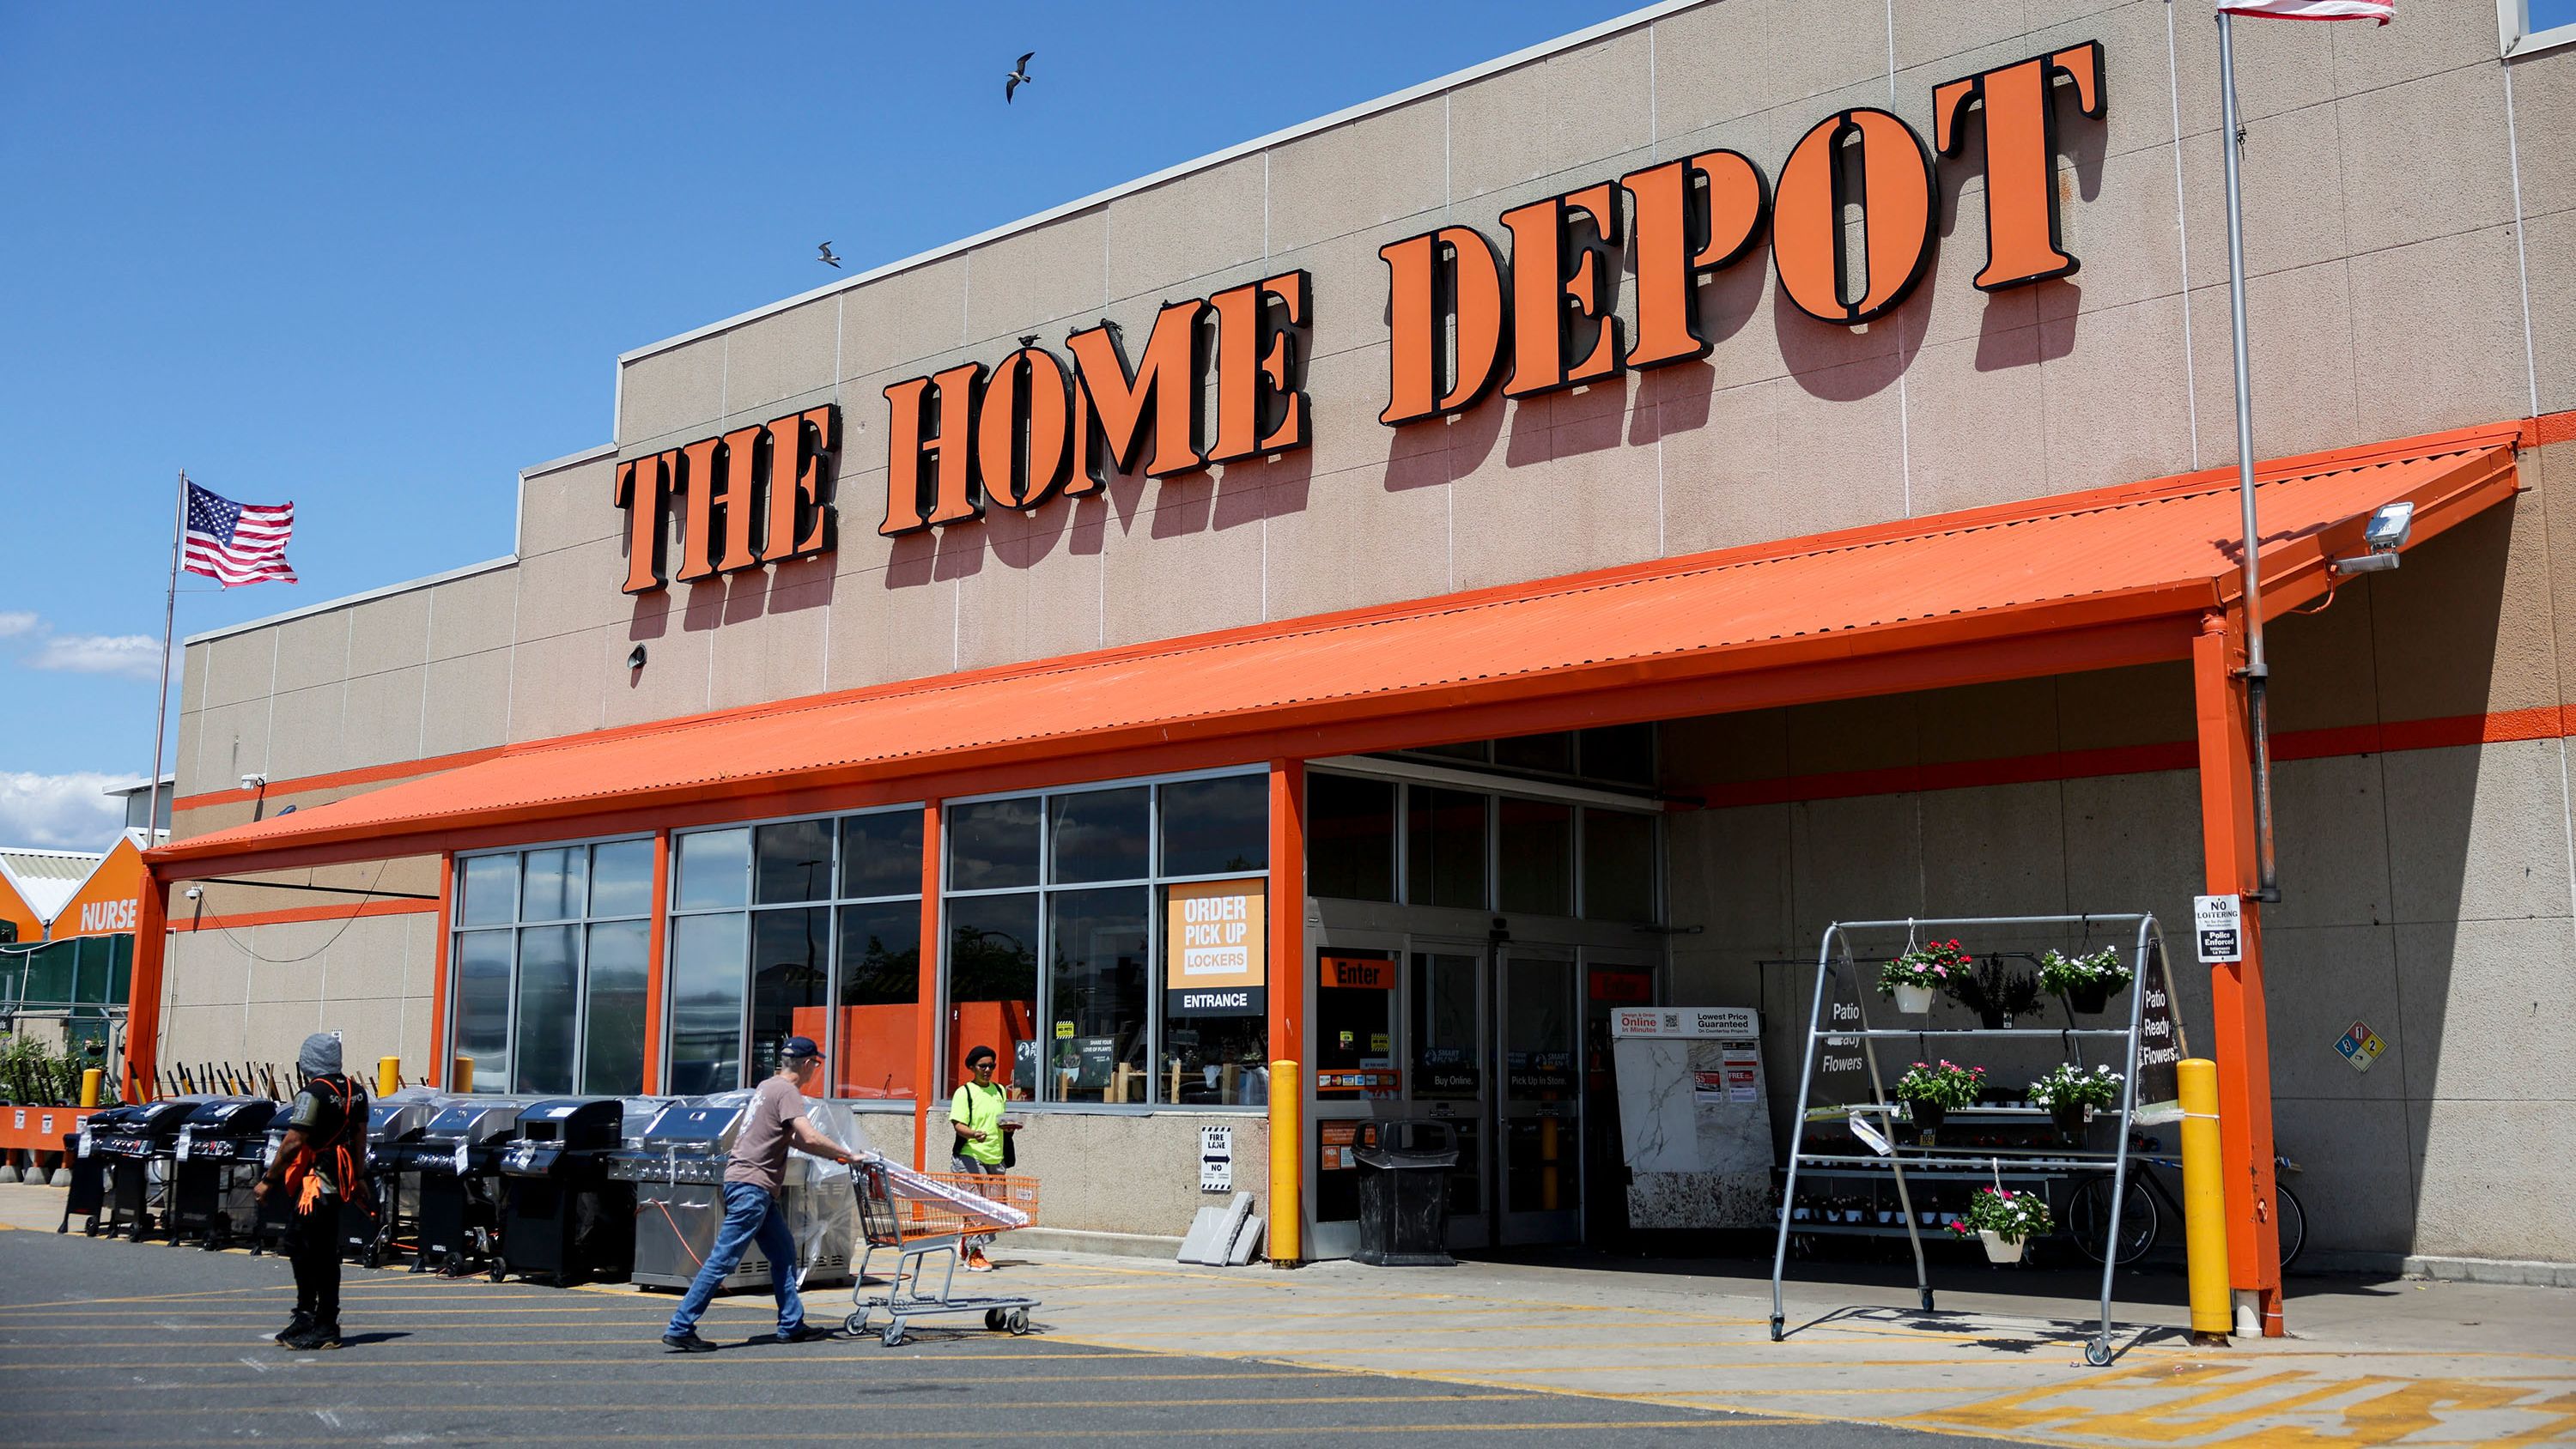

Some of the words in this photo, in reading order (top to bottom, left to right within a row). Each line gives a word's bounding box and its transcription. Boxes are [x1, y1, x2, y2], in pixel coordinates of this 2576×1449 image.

[615, 403, 841, 594] THE
[878, 269, 1313, 537] HOME
[1378, 39, 2106, 427] DEPOT
[1185, 895, 1247, 923] ORDER
[2211, 901, 2227, 911] NO
[81, 899, 137, 931] NURSE
[1185, 925, 1221, 946] PICK
[1226, 923, 1247, 943] UP
[1188, 954, 1244, 967] LOCKERS
[1337, 962, 1381, 985] Enter
[1184, 993, 1247, 1008] ENTRANCE
[2146, 989, 2166, 1009] Patio
[1834, 1003, 1859, 1020] Patio
[1622, 1017, 1656, 1027] Online
[2144, 1016, 2169, 1038] Ready
[2344, 1040, 2351, 1051] 3
[2369, 1040, 2375, 1052] 2
[1823, 1055, 1862, 1072] Flowers
[2143, 1046, 2175, 1065] Flowers
[1435, 1076, 1448, 1087] Buy
[1449, 1076, 1473, 1085] Online.
[1512, 1076, 1527, 1085] Pick
[1528, 1076, 1538, 1086] Up
[1546, 1076, 1566, 1085] Store.
